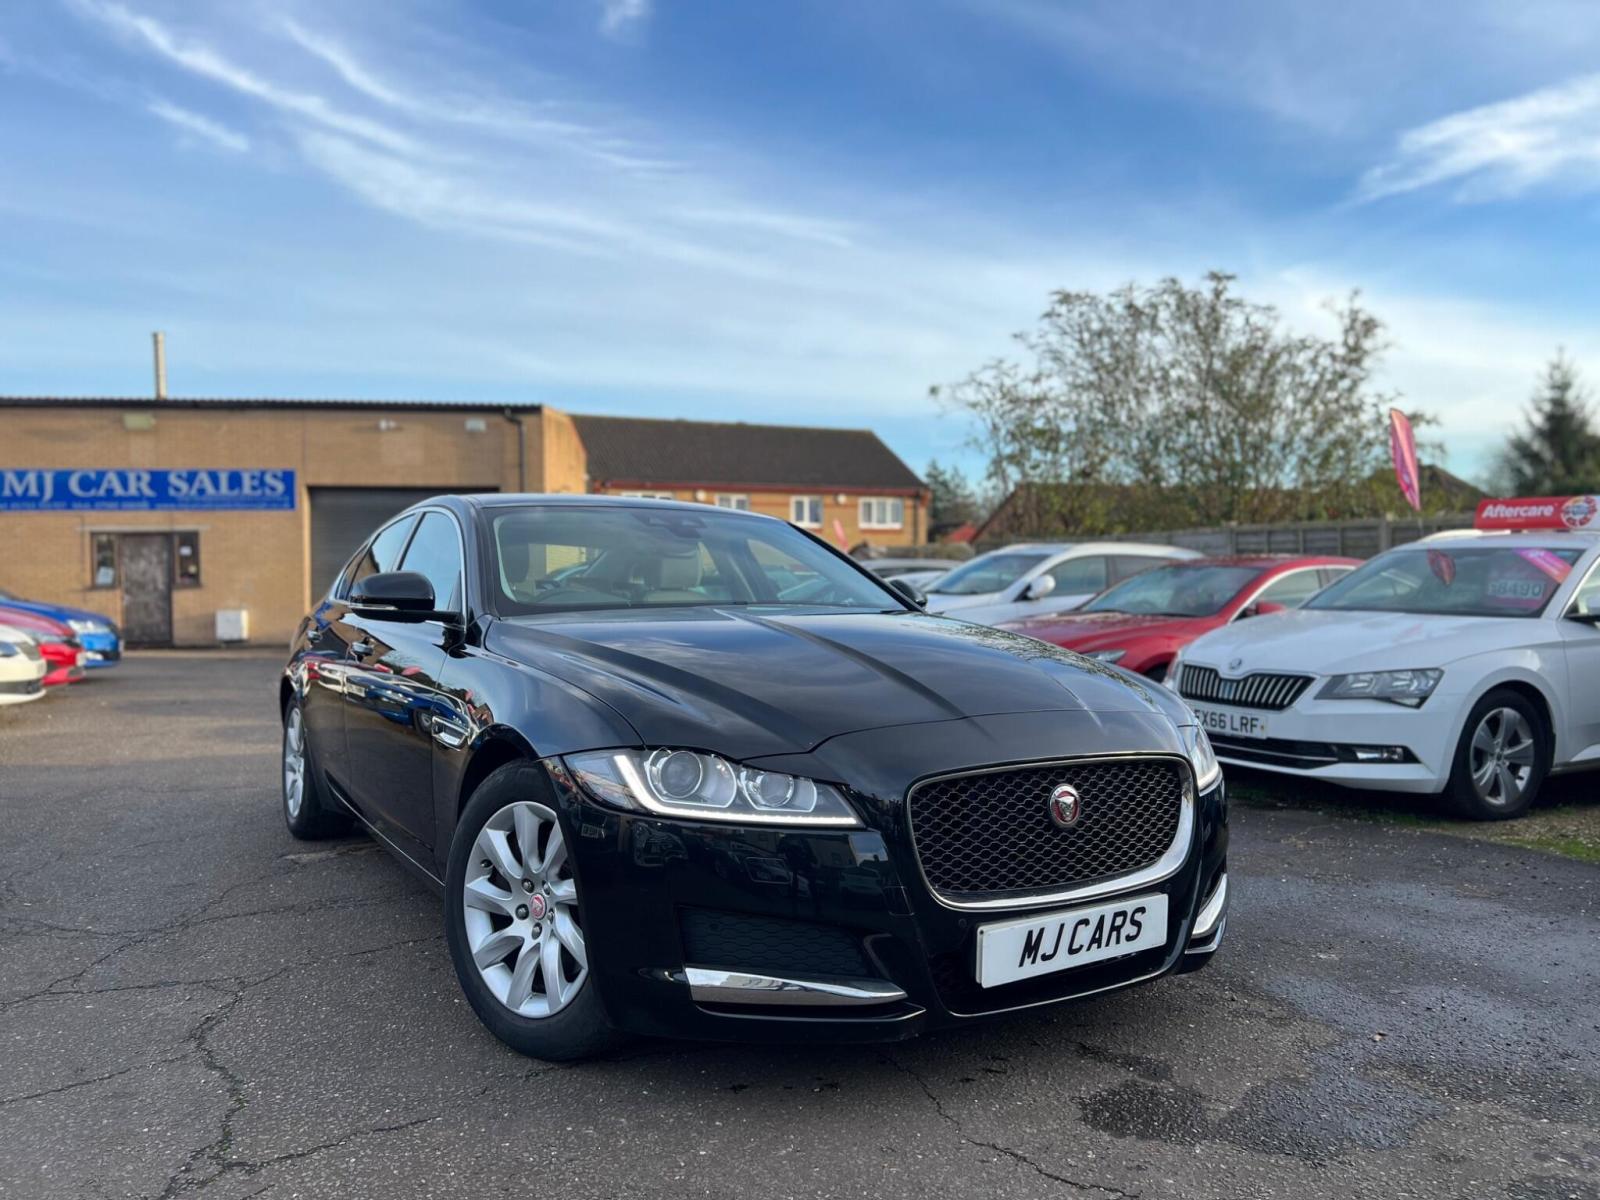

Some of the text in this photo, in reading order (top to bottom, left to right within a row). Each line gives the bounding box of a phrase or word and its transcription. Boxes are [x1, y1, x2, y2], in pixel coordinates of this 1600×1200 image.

[2, 470, 286, 501] MJ CAR SALES
[1481, 504, 1554, 518] Aftercare
[1230, 714, 1259, 733] LRF
[1018, 906, 1147, 968] MJ CARS
